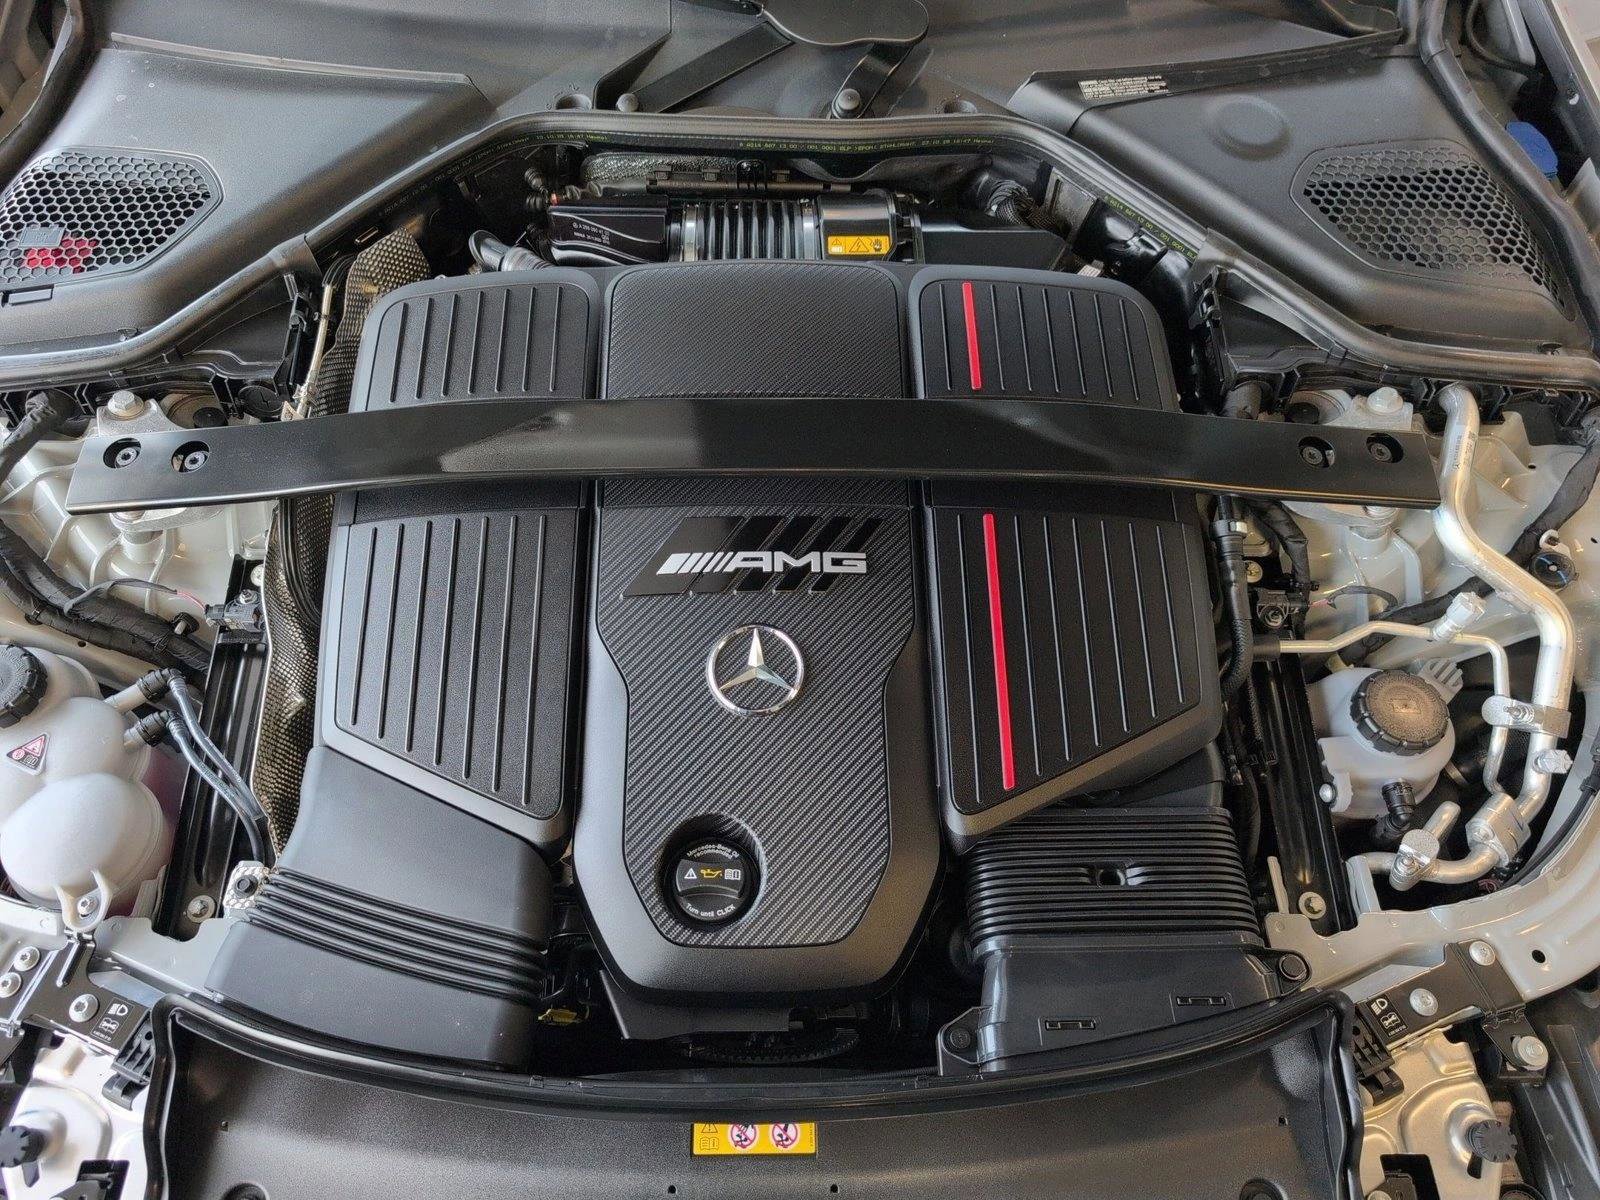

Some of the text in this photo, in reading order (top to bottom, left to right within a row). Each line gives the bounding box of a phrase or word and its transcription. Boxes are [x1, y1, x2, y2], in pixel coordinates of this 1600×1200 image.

[722, 551, 867, 573] AMG
[686, 902, 699, 915] Turn
[716, 903, 736, 917] CLICK
